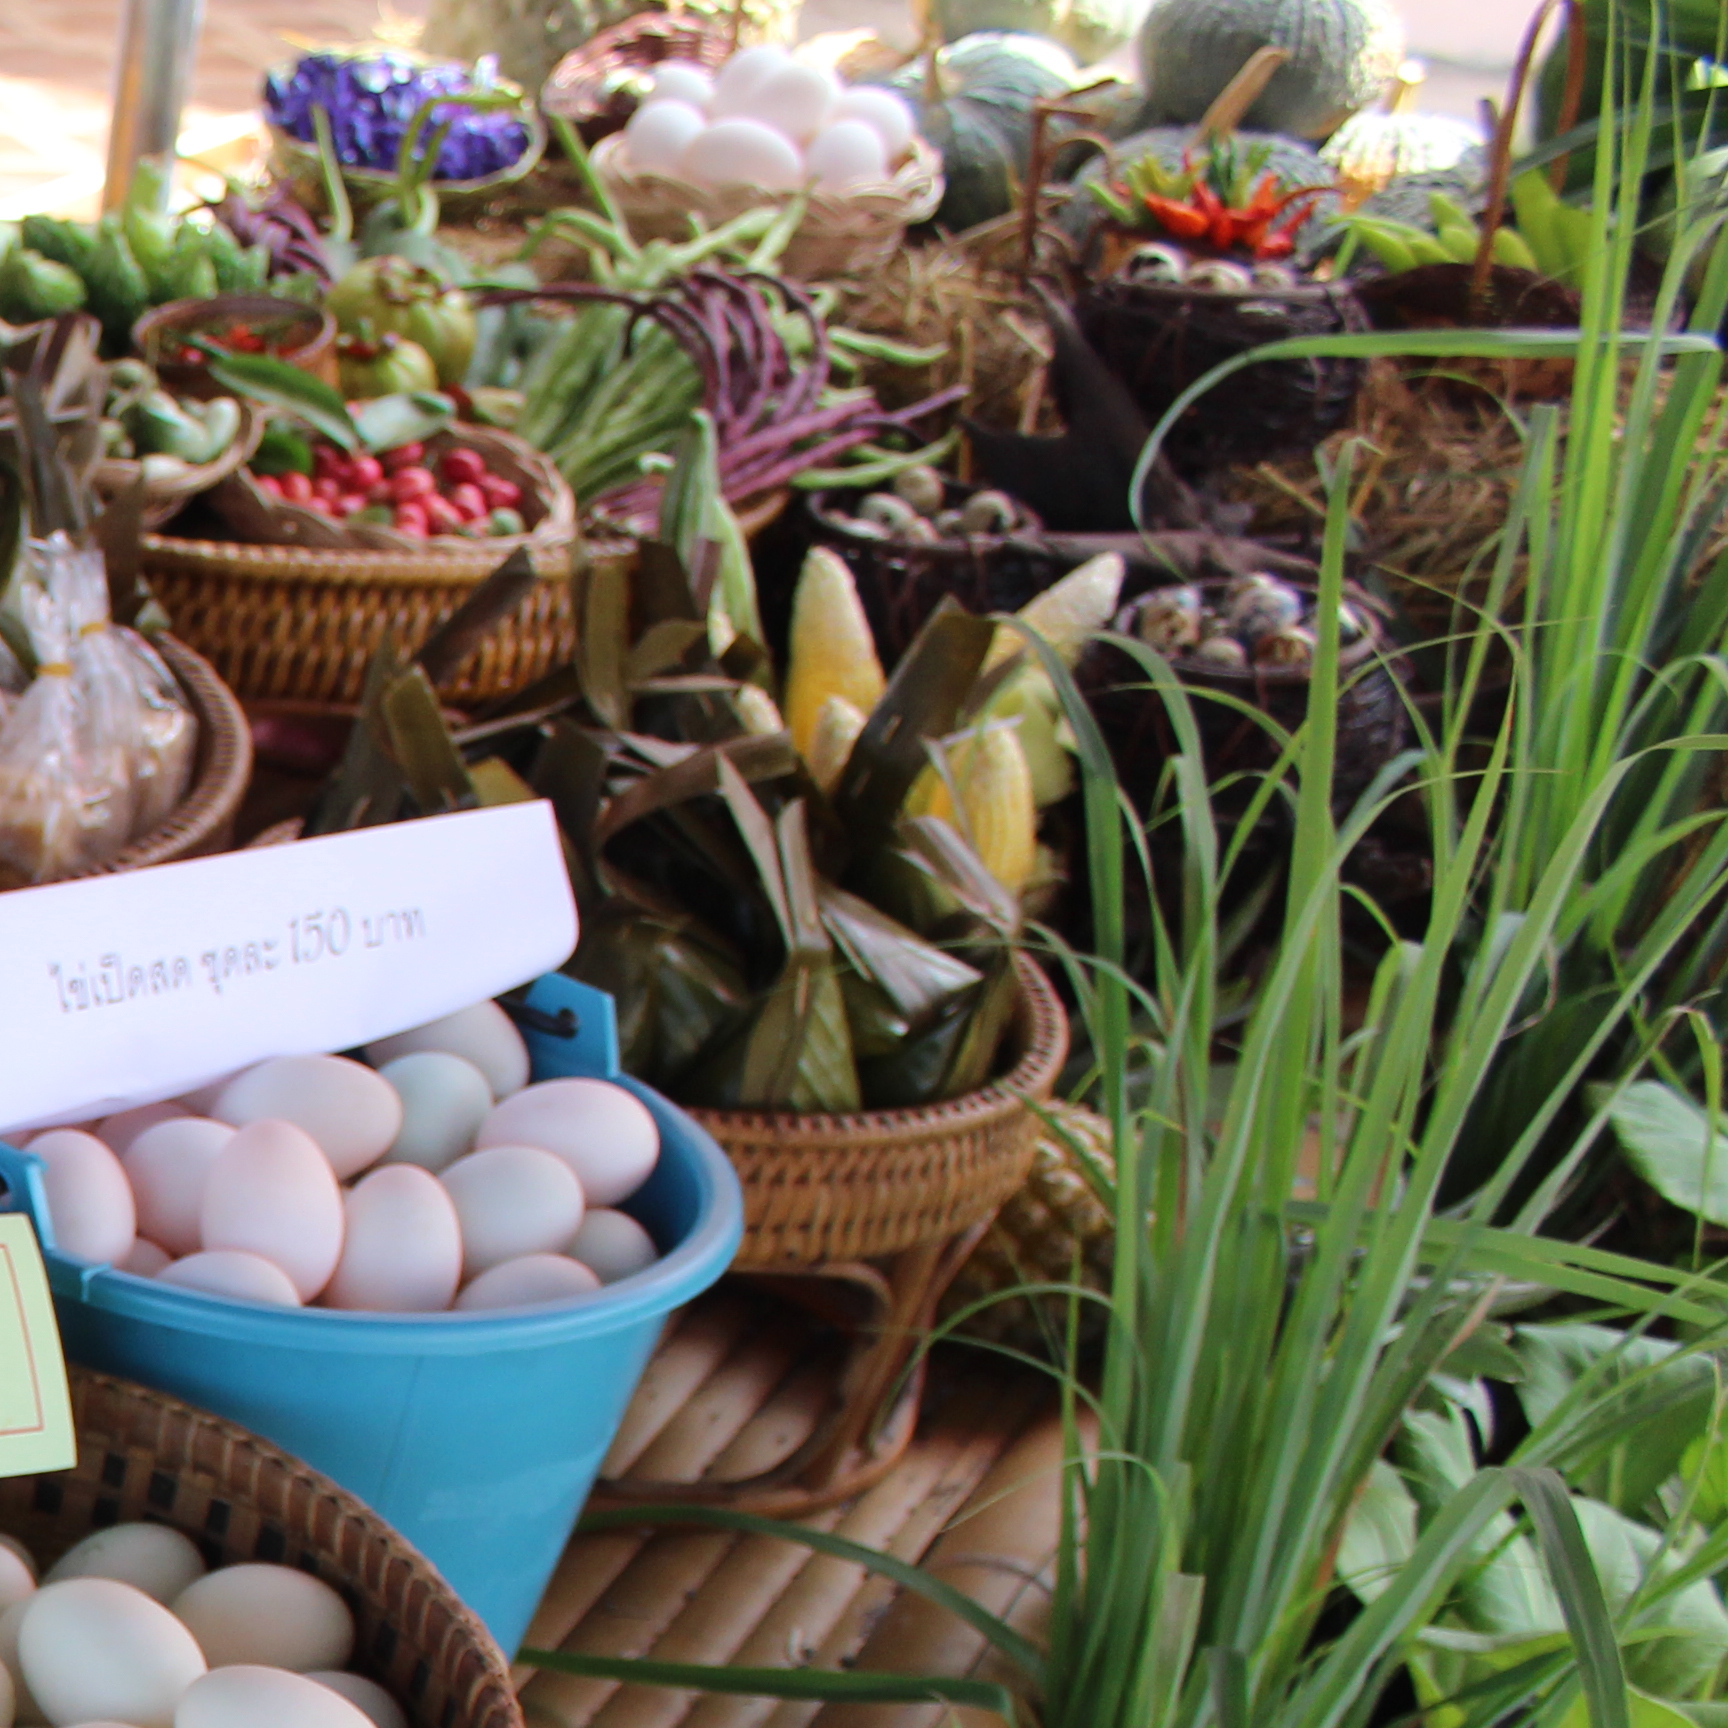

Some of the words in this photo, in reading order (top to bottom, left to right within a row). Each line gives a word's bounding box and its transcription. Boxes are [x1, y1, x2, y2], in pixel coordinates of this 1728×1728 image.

[48, 953, 192, 1014] ไข่เป็ดสด
[201, 938, 281, 995] ชุดละ
[289, 907, 353, 964] 150
[362, 907, 427, 948] บาท
